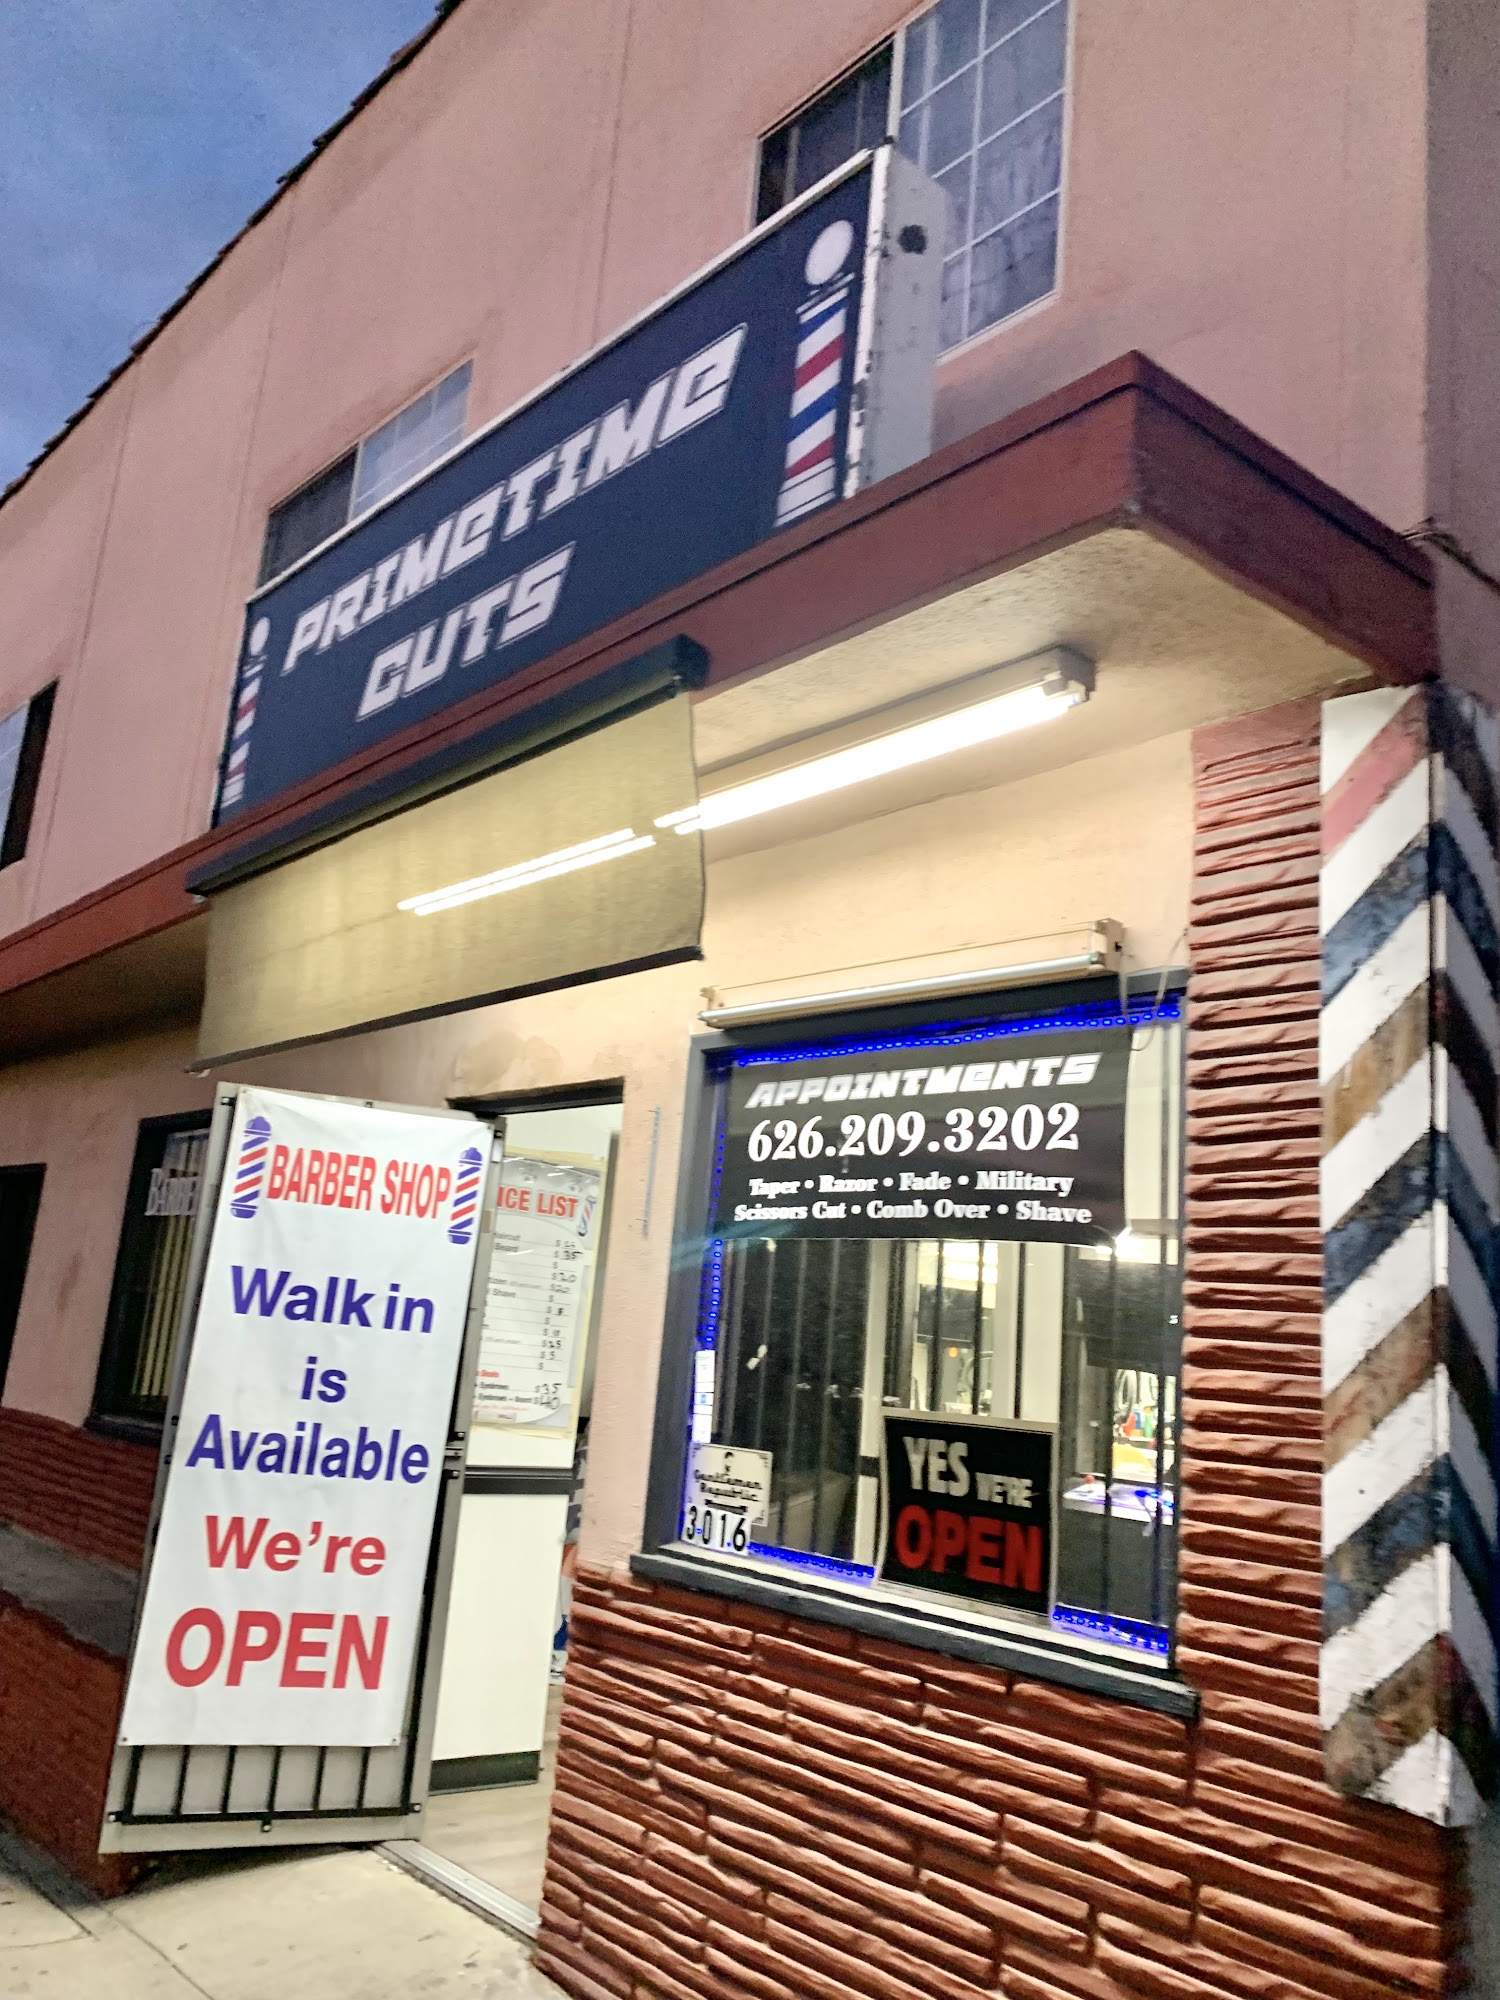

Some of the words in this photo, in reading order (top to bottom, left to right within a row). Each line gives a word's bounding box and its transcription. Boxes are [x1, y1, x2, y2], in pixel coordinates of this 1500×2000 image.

[355, 541, 576, 722] CUTS
[744, 1052, 1103, 1108] APPOINTMENTS
[747, 1102, 1080, 1162] 626.209.3202
[266, 1144, 377, 1212] BARBER
[380, 1159, 452, 1220] SHOP
[496, 1185, 532, 1212] ICE
[537, 1192, 579, 1218] LIST
[734, 1203, 808, 1222] Scissors
[812, 1200, 847, 1219] Cut
[866, 1199, 929, 1219] Comb
[934, 1198, 991, 1219] Over
[1015, 1199, 1093, 1224] Shave
[749, 1178, 801, 1200] Taper
[818, 1174, 879, 1193] Razor
[898, 1170, 952, 1191] Fade
[974, 1170, 1075, 1198] Military
[230, 1265, 377, 1328] Walk
[382, 1283, 436, 1334] in
[300, 1356, 349, 1403] is
[186, 1413, 430, 1483] Available
[902, 1435, 971, 1497] YES
[205, 1515, 387, 1576] We're
[686, 1504, 747, 1552] 3016
[895, 1504, 1043, 1593] OPEN
[165, 1607, 390, 1690] OPEN
